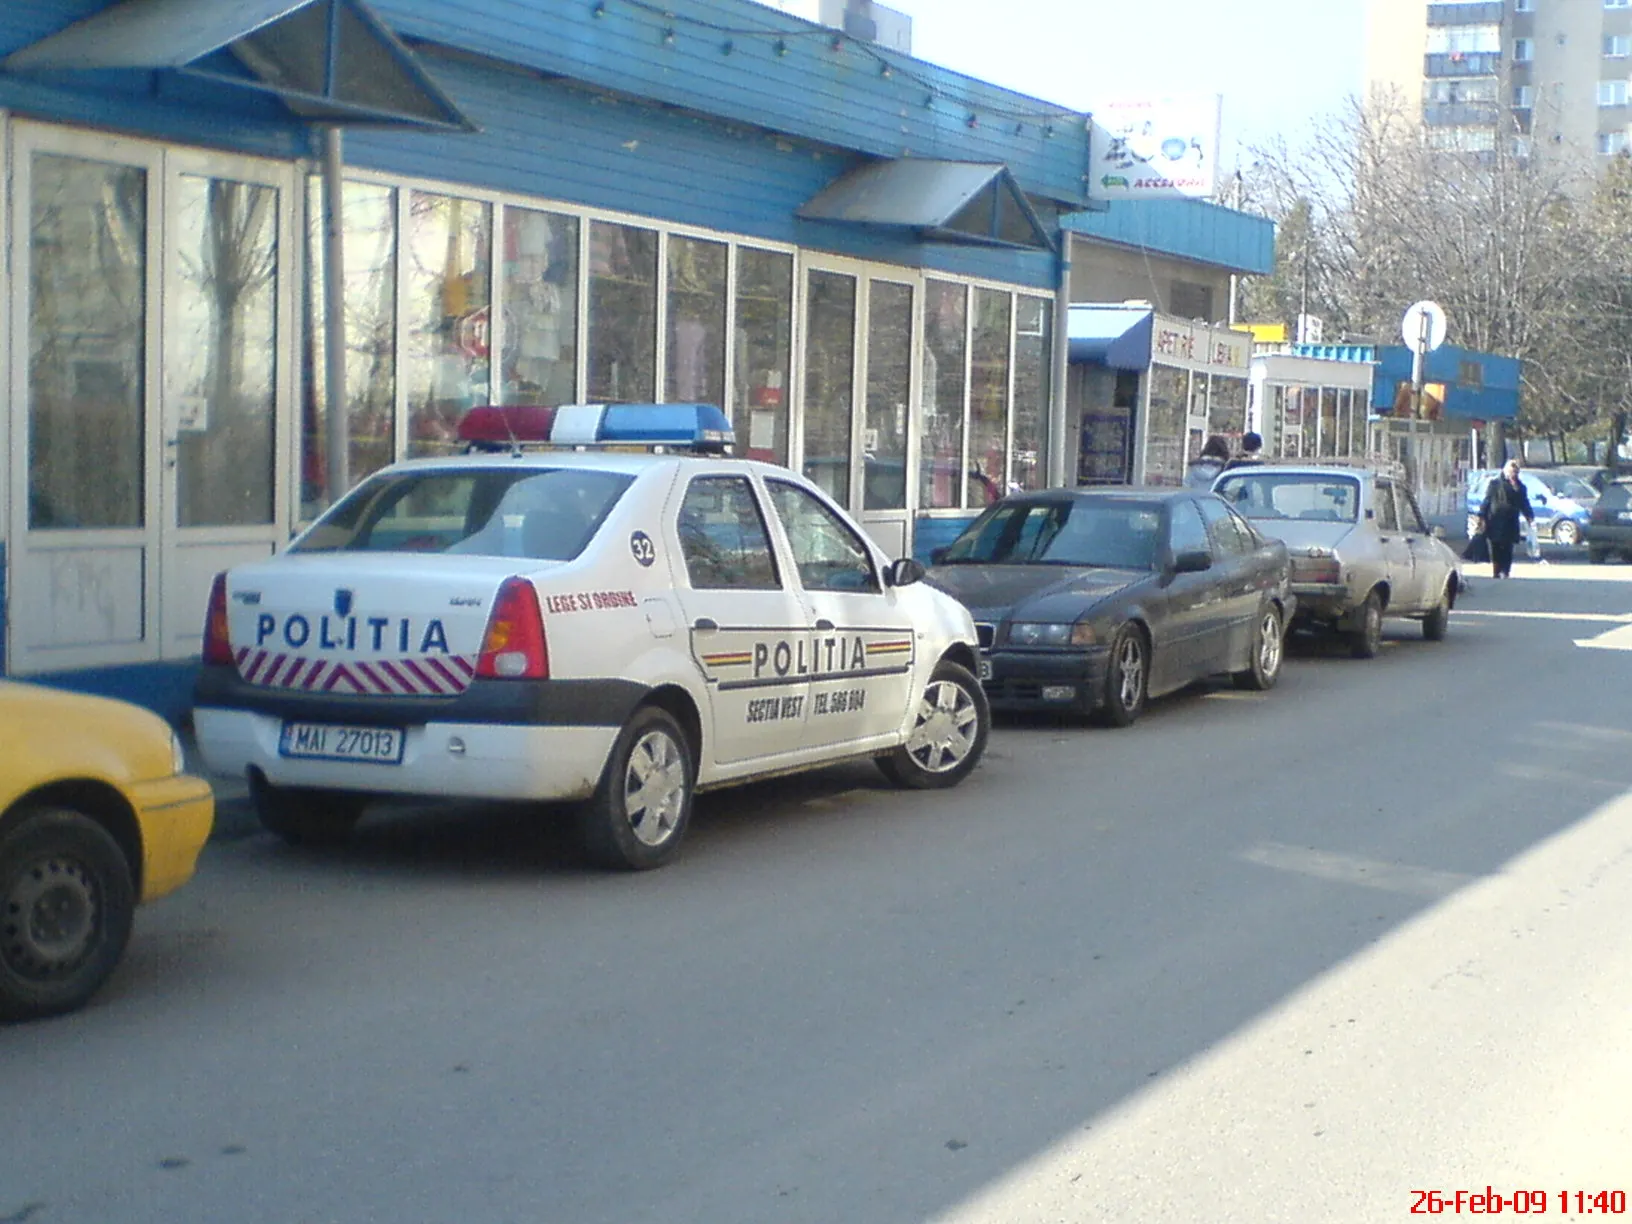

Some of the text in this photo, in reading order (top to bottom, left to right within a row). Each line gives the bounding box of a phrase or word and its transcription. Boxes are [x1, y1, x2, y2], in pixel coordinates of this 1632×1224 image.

[632, 539, 655, 559] 32
[546, 594, 577, 613] LEGE
[256, 613, 449, 653] POLITIA
[754, 637, 867, 677] POLITIA
[295, 727, 394, 757] MAI 27013
